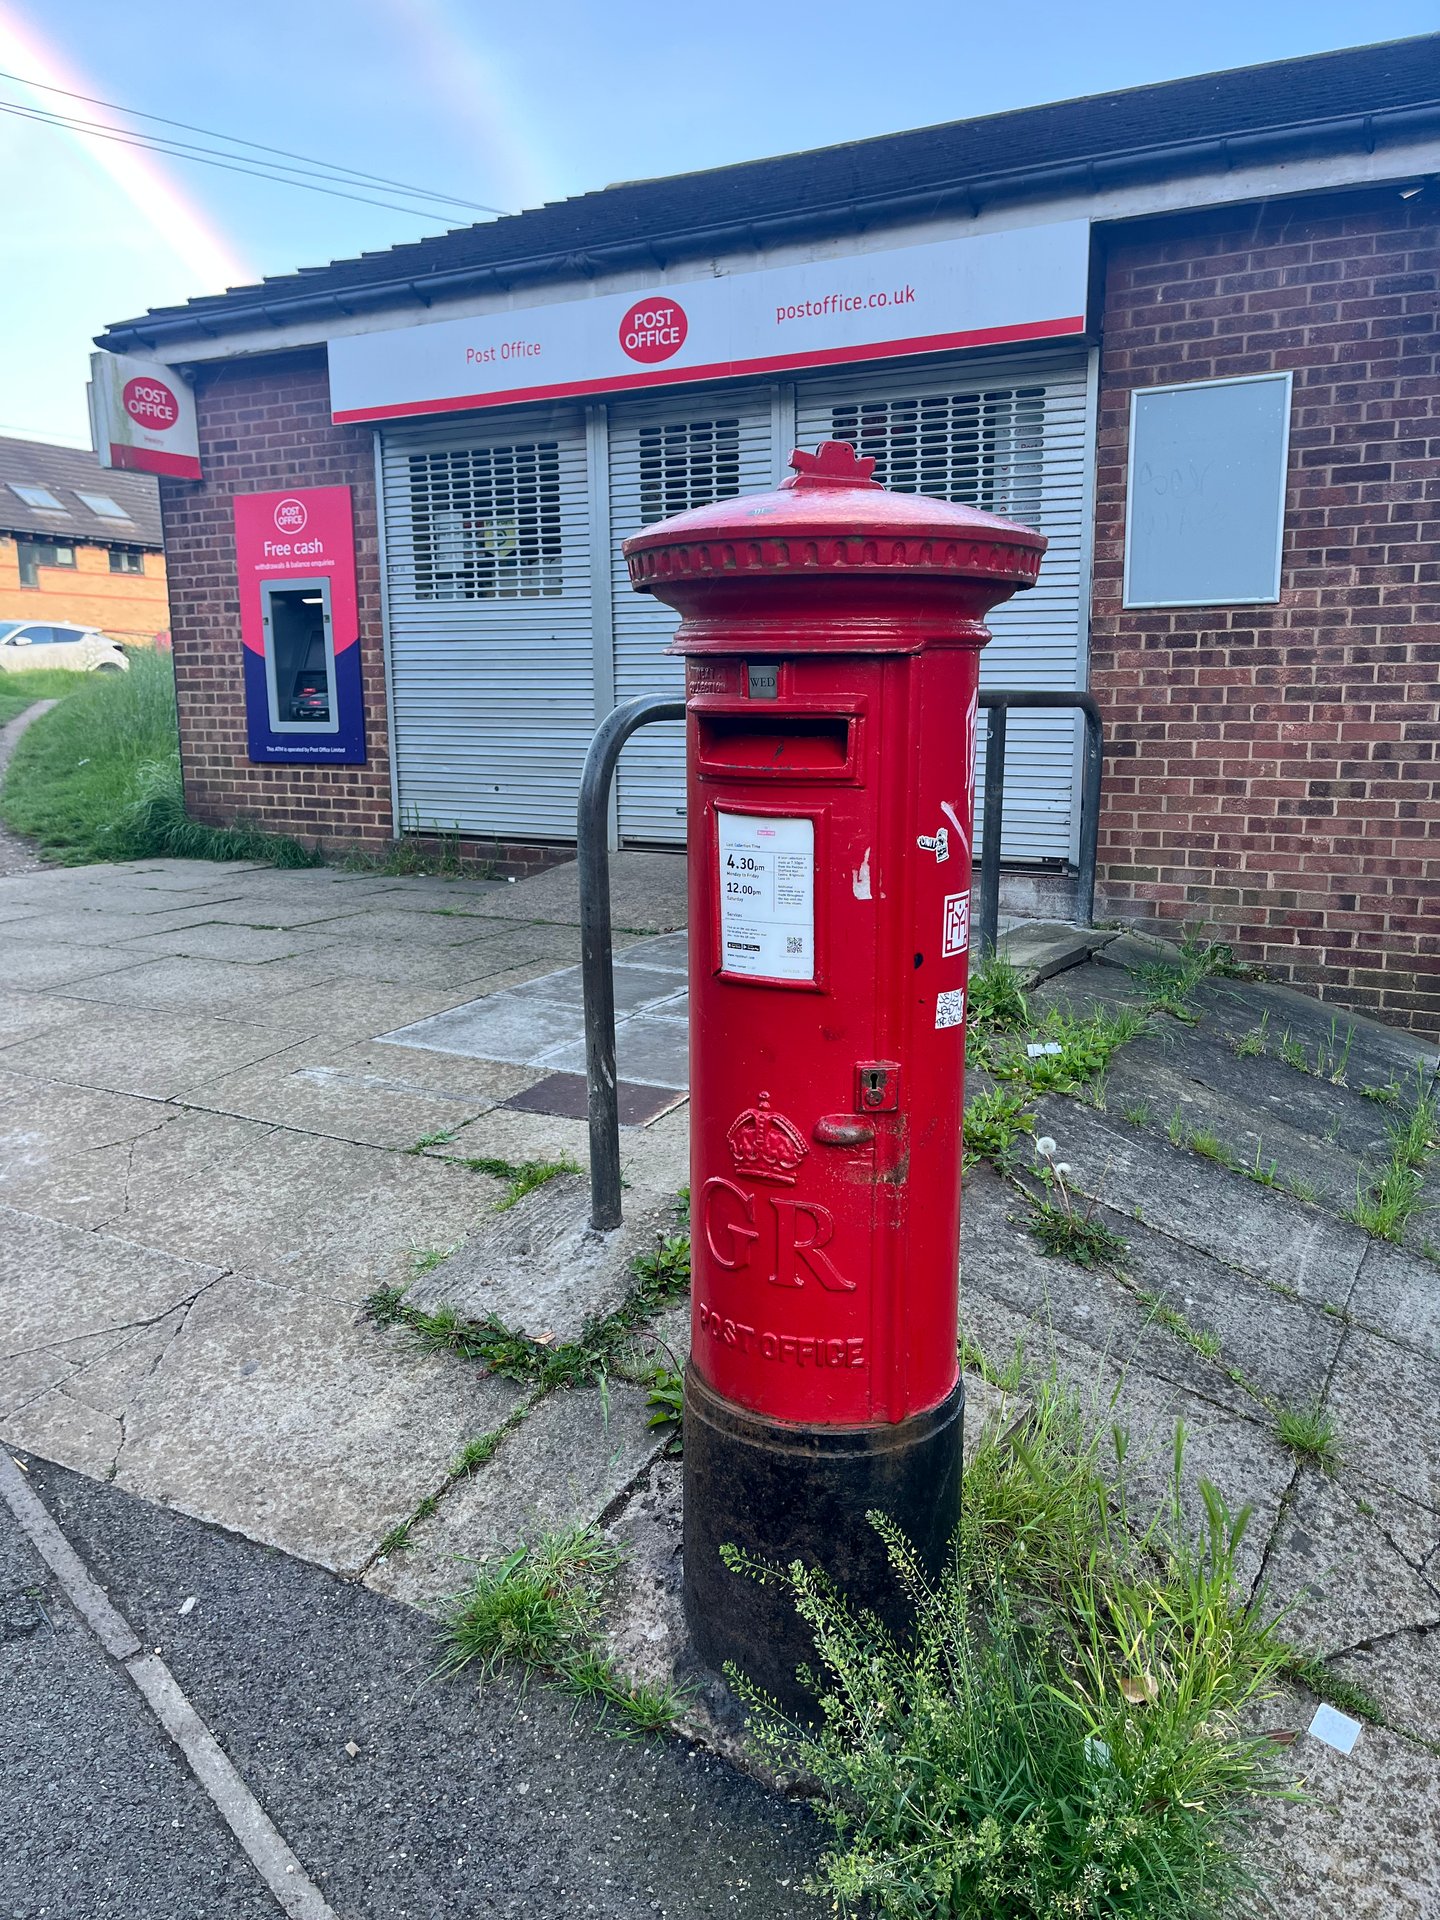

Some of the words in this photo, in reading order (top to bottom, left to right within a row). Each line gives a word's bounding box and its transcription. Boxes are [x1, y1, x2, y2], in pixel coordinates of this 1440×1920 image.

[776, 285, 916, 324] postoffice.co.uk
[634, 309, 674, 330] POST
[625, 327, 680, 350] OFFICE
[466, 346, 496, 364] Post
[501, 341, 542, 361] Office
[135, 386, 167, 404] POST
[128, 400, 173, 420] OFFICE
[278, 515, 303, 526] OFFICE
[282, 506, 300, 516] POST
[264, 541, 291, 557] Free
[294, 538, 323, 555] cash
[311, 560, 335, 568] enquiries
[750, 677, 776, 687] WED
[727, 854, 765, 871] 4.30pm
[727, 882, 761, 895] 12.00pm
[701, 1176, 857, 1291] GR
[700, 1302, 755, 1350] POST
[761, 1331, 865, 1369] OFFICE
